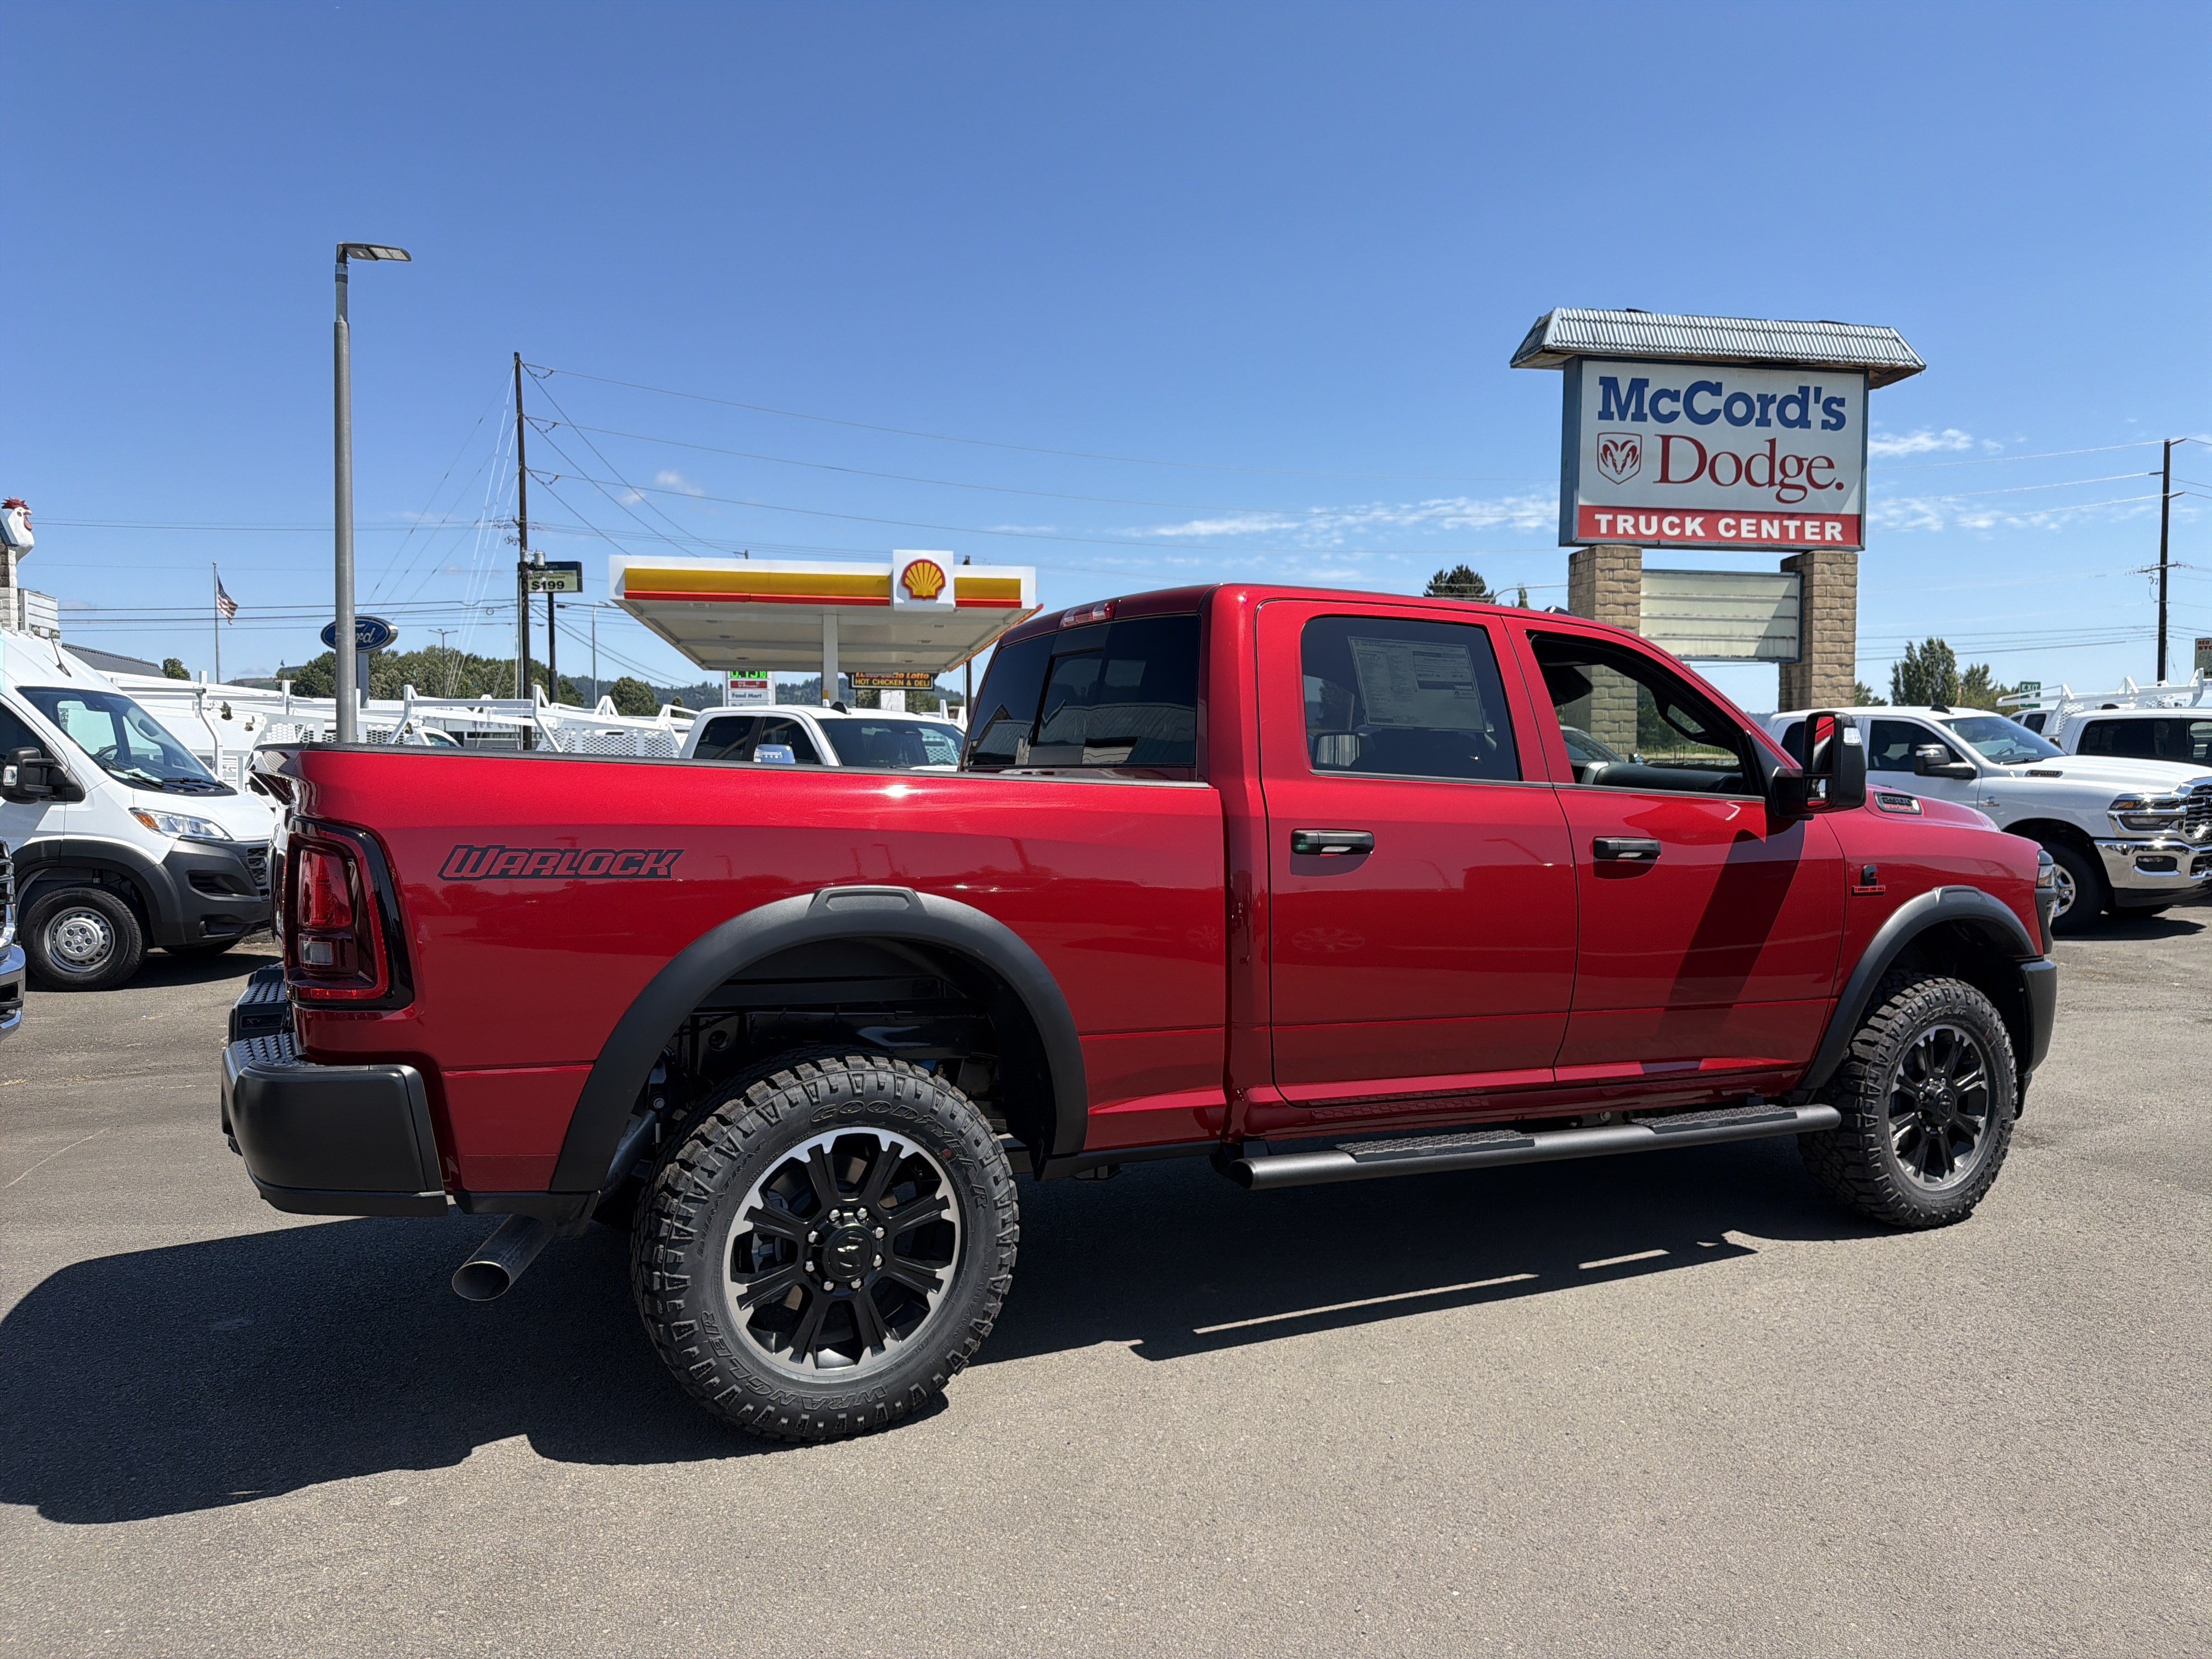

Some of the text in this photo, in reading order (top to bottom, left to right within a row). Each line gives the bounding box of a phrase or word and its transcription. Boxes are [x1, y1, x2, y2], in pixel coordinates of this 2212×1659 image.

[1598, 376, 1846, 431] McCord's
[1594, 514, 1843, 541] TRUCK CENTER
[437, 844, 685, 881] WARLOCK
[811, 1100, 989, 1209] GOODYEAR
[701, 1310, 887, 1411] WRANGLER
